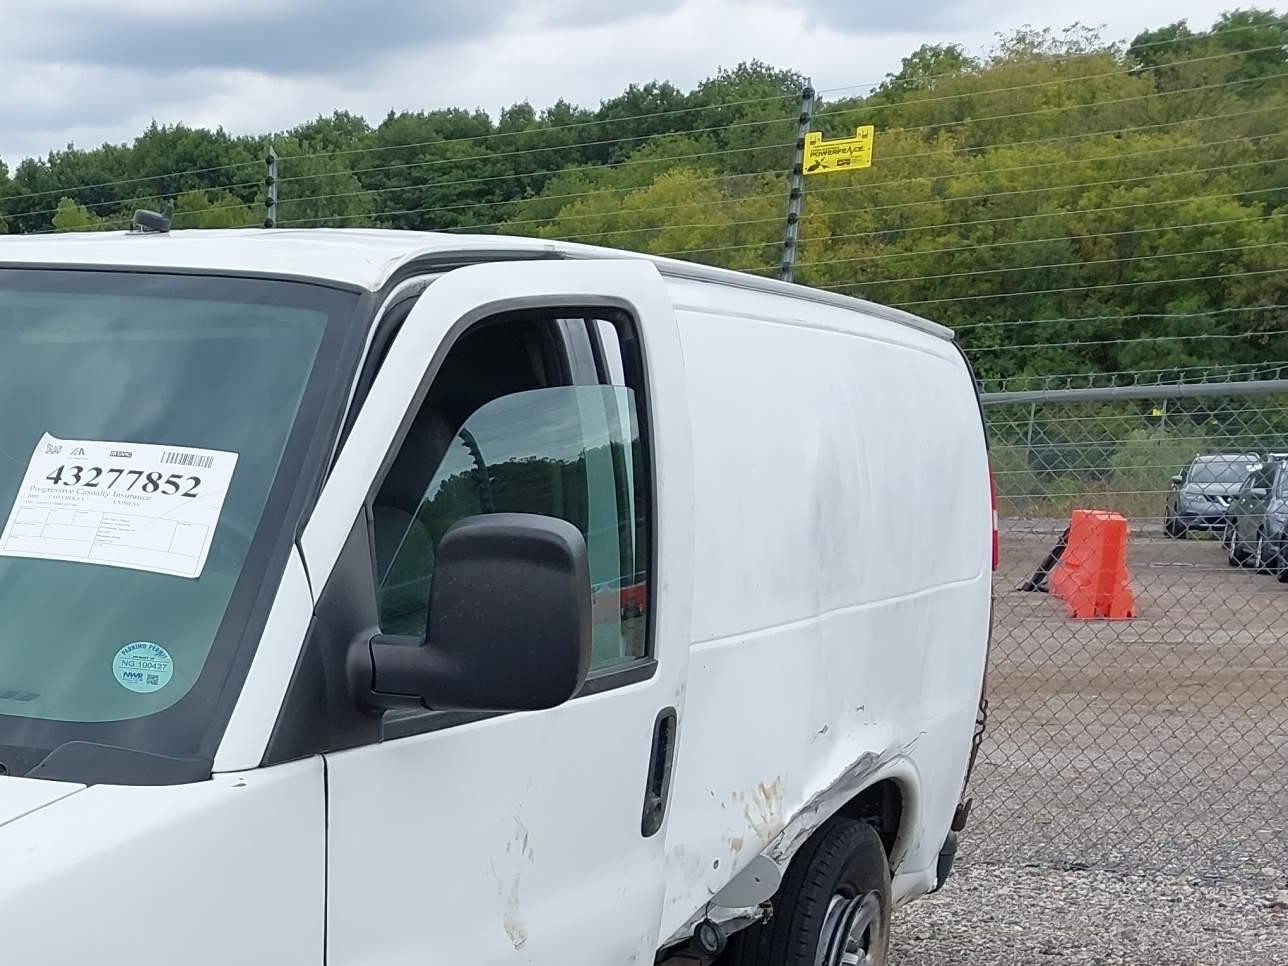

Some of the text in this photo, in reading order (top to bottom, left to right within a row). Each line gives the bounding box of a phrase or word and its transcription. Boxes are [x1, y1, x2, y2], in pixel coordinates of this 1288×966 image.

[46, 465, 202, 498] 43277852
[76, 488, 110, 498] Casualty
[113, 490, 152, 501] Insurance
